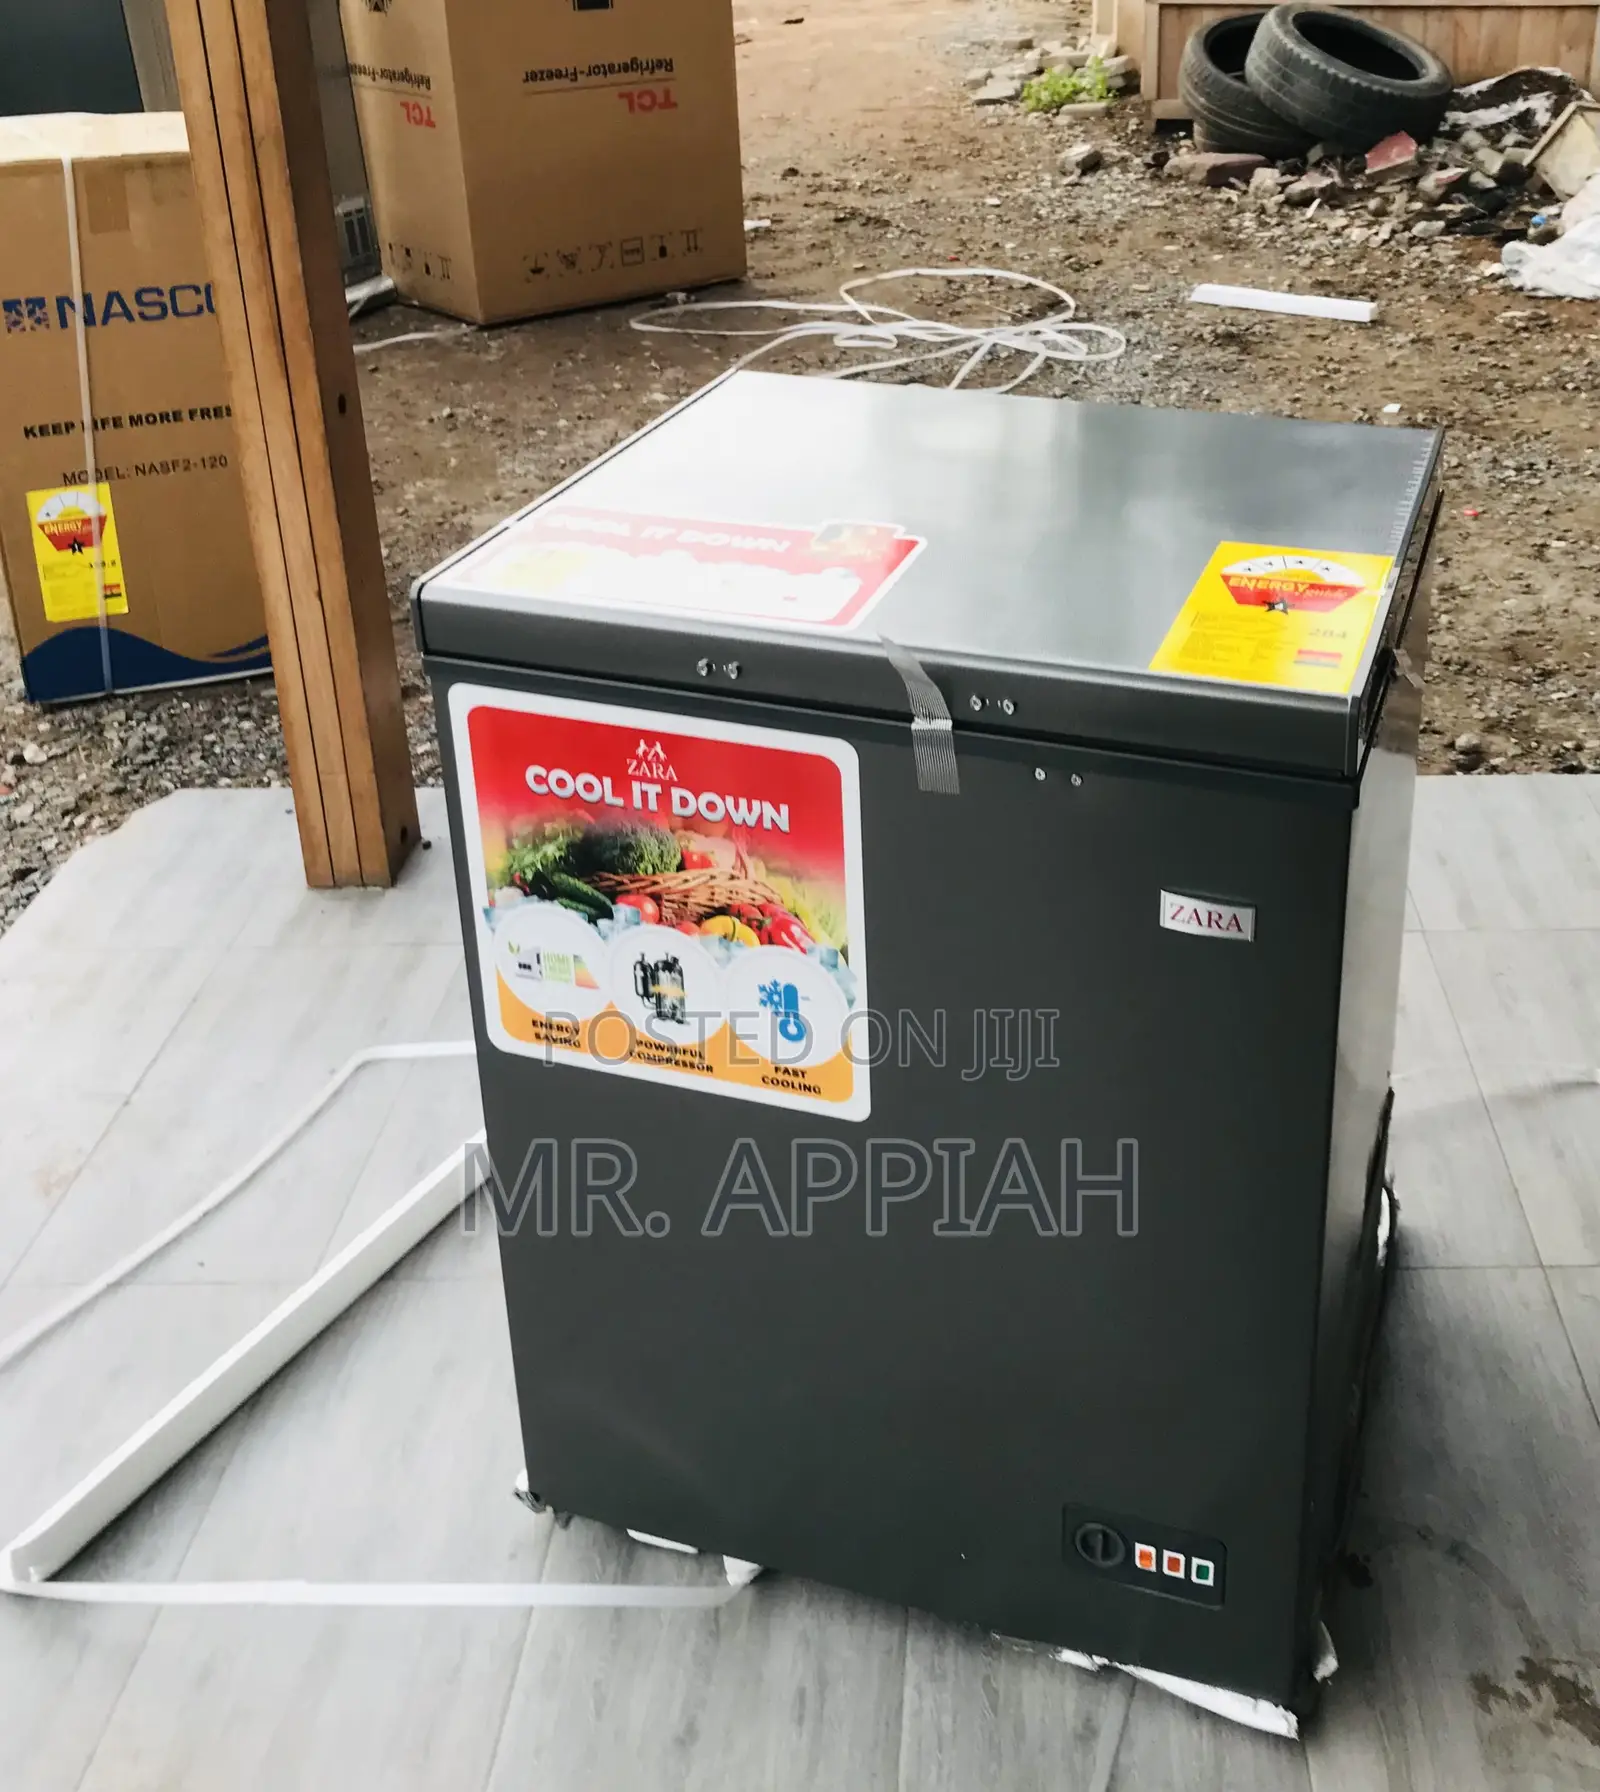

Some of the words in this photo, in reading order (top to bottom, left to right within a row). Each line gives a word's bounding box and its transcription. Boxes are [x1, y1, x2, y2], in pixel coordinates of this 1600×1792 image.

[522, 57, 674, 84] Refrigerator-Freezer
[618, 87, 678, 114] TCL
[400, 101, 436, 128] TCL
[56, 283, 216, 329] NASC
[23, 420, 76, 440] KEEP
[129, 409, 184, 427] MORE
[641, 525, 676, 542] IT
[677, 527, 791, 553] DOWN
[1229, 575, 1309, 595] ENERGY
[626, 758, 678, 782] ZARA
[525, 765, 624, 808] COOL
[630, 781, 663, 812] IT
[671, 787, 790, 833] DOWN
[1169, 902, 1244, 933] ZARA
[532, 1019, 580, 1037] ENERGY
[534, 1031, 581, 1049] SAVING
[635, 1038, 706, 1060] POWERFUL
[629, 1050, 714, 1074] COMPRESSOR
[774, 1065, 807, 1080] FAST
[761, 1075, 822, 1096] COOLING
